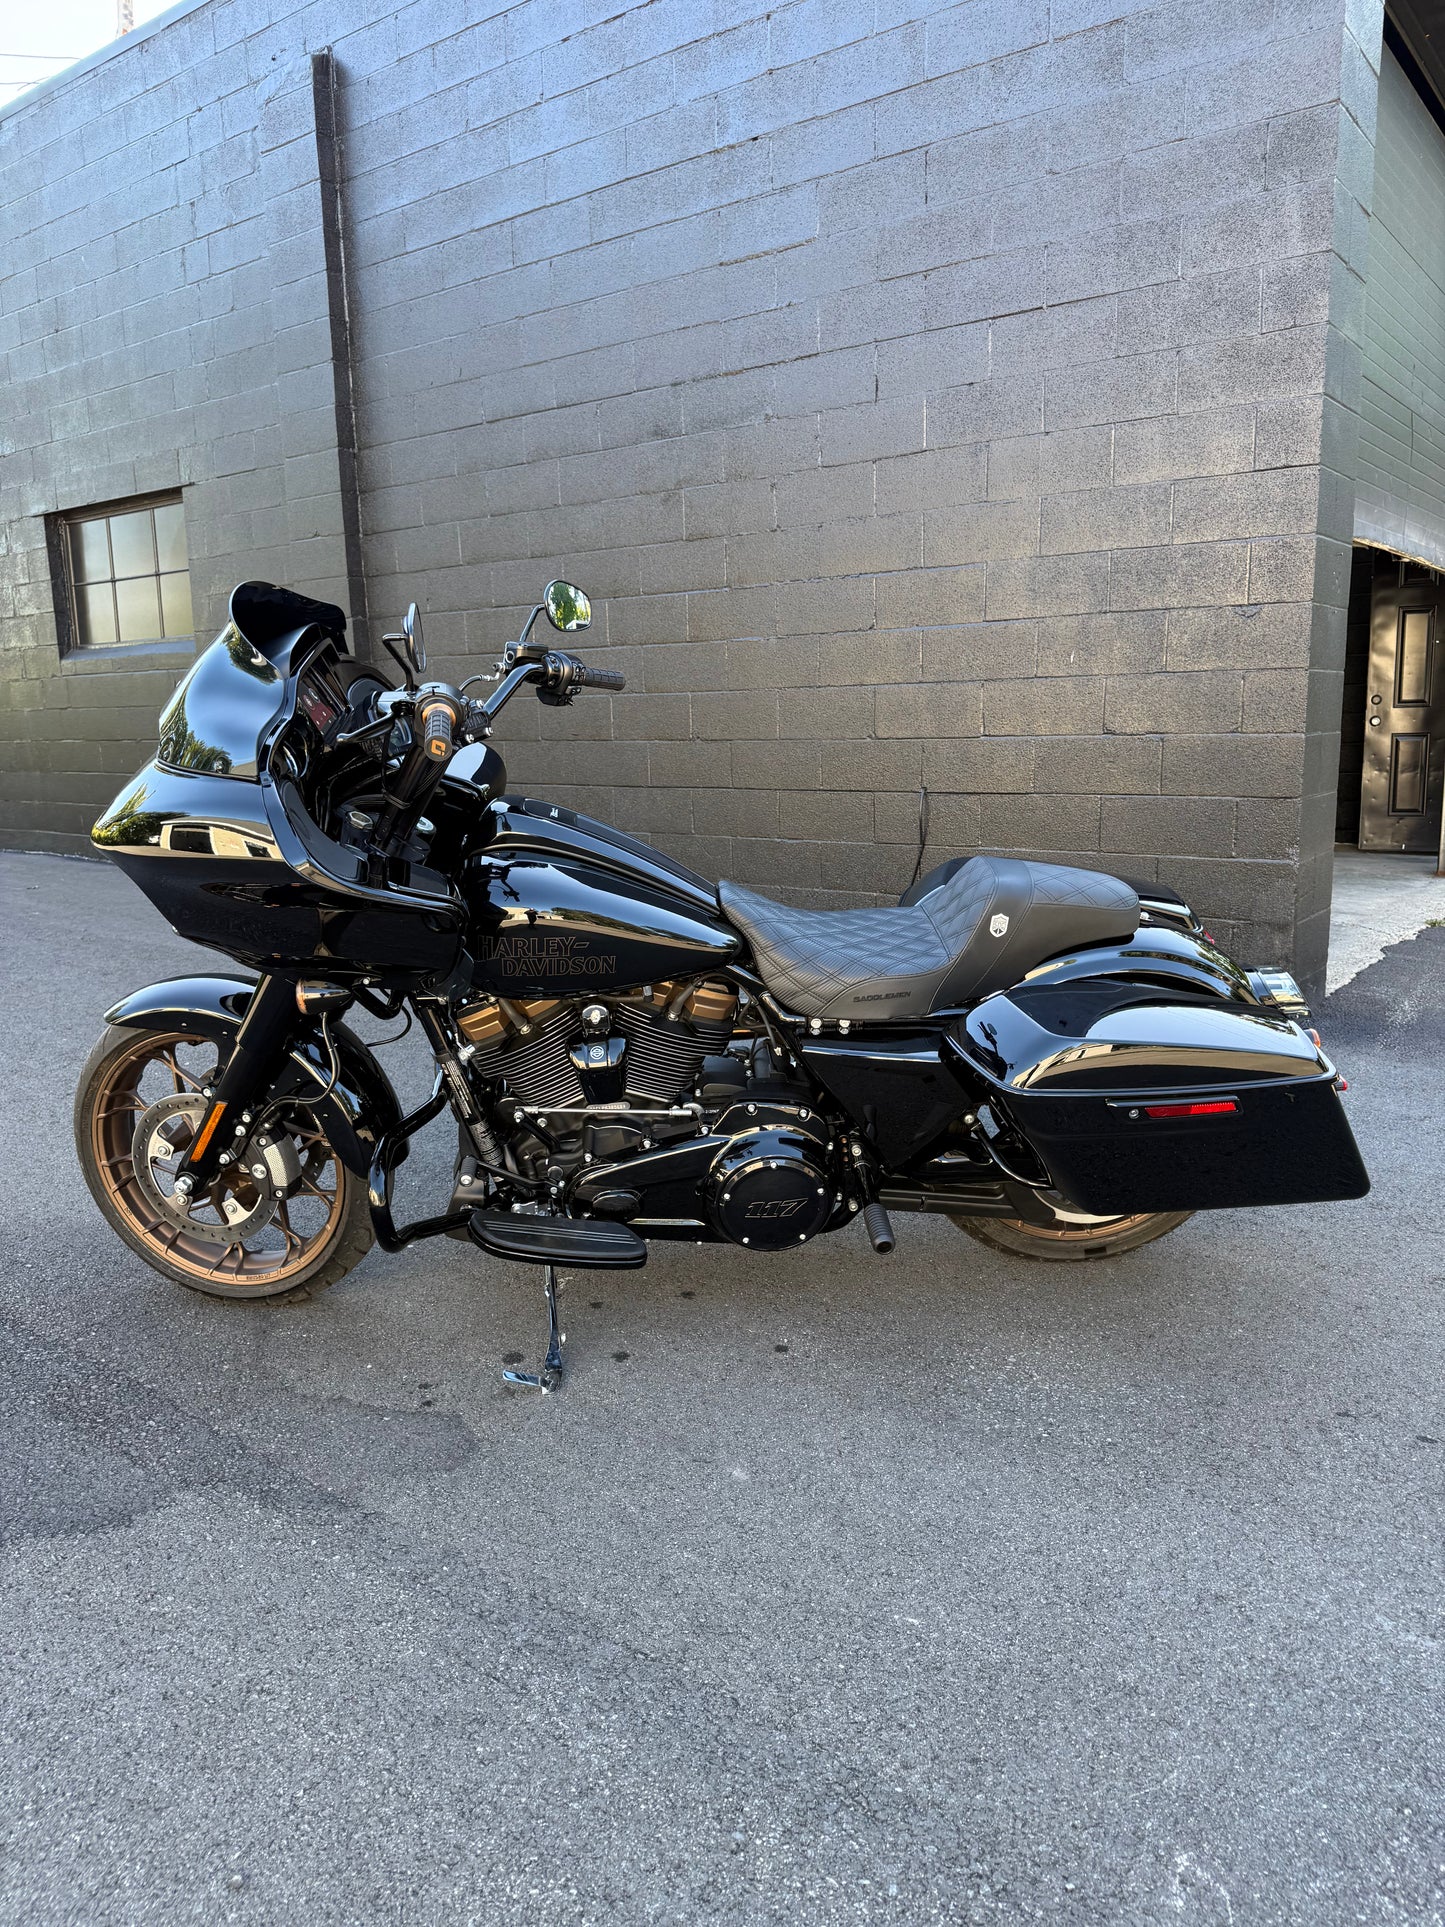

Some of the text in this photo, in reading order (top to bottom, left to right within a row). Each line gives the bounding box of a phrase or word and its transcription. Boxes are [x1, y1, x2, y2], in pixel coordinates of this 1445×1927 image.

[501, 955, 617, 977] DAVIDSON
[853, 991, 912, 1003] SADDLEMEN
[744, 1197, 809, 1219] 117
